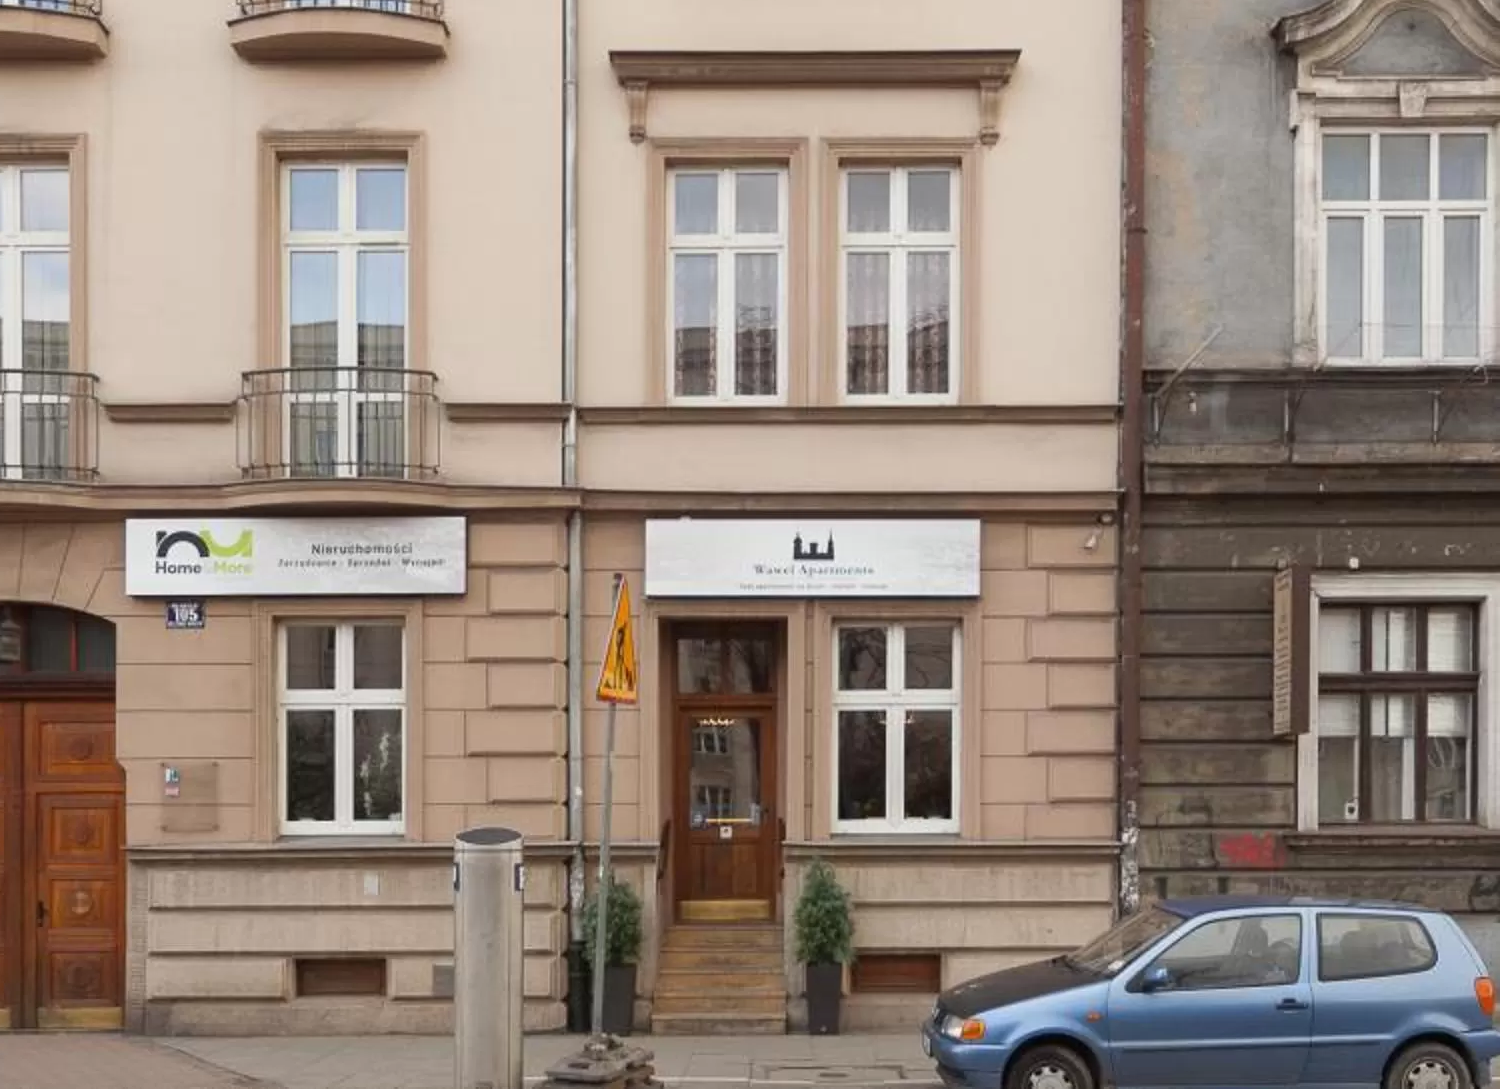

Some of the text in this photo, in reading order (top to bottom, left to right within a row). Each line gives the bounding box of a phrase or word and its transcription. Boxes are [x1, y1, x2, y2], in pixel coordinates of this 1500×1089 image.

[311, 541, 414, 556] Nieruchomości
[155, 561, 202, 575] Home
[213, 561, 253, 575] More
[753, 564, 795, 576] Wawel
